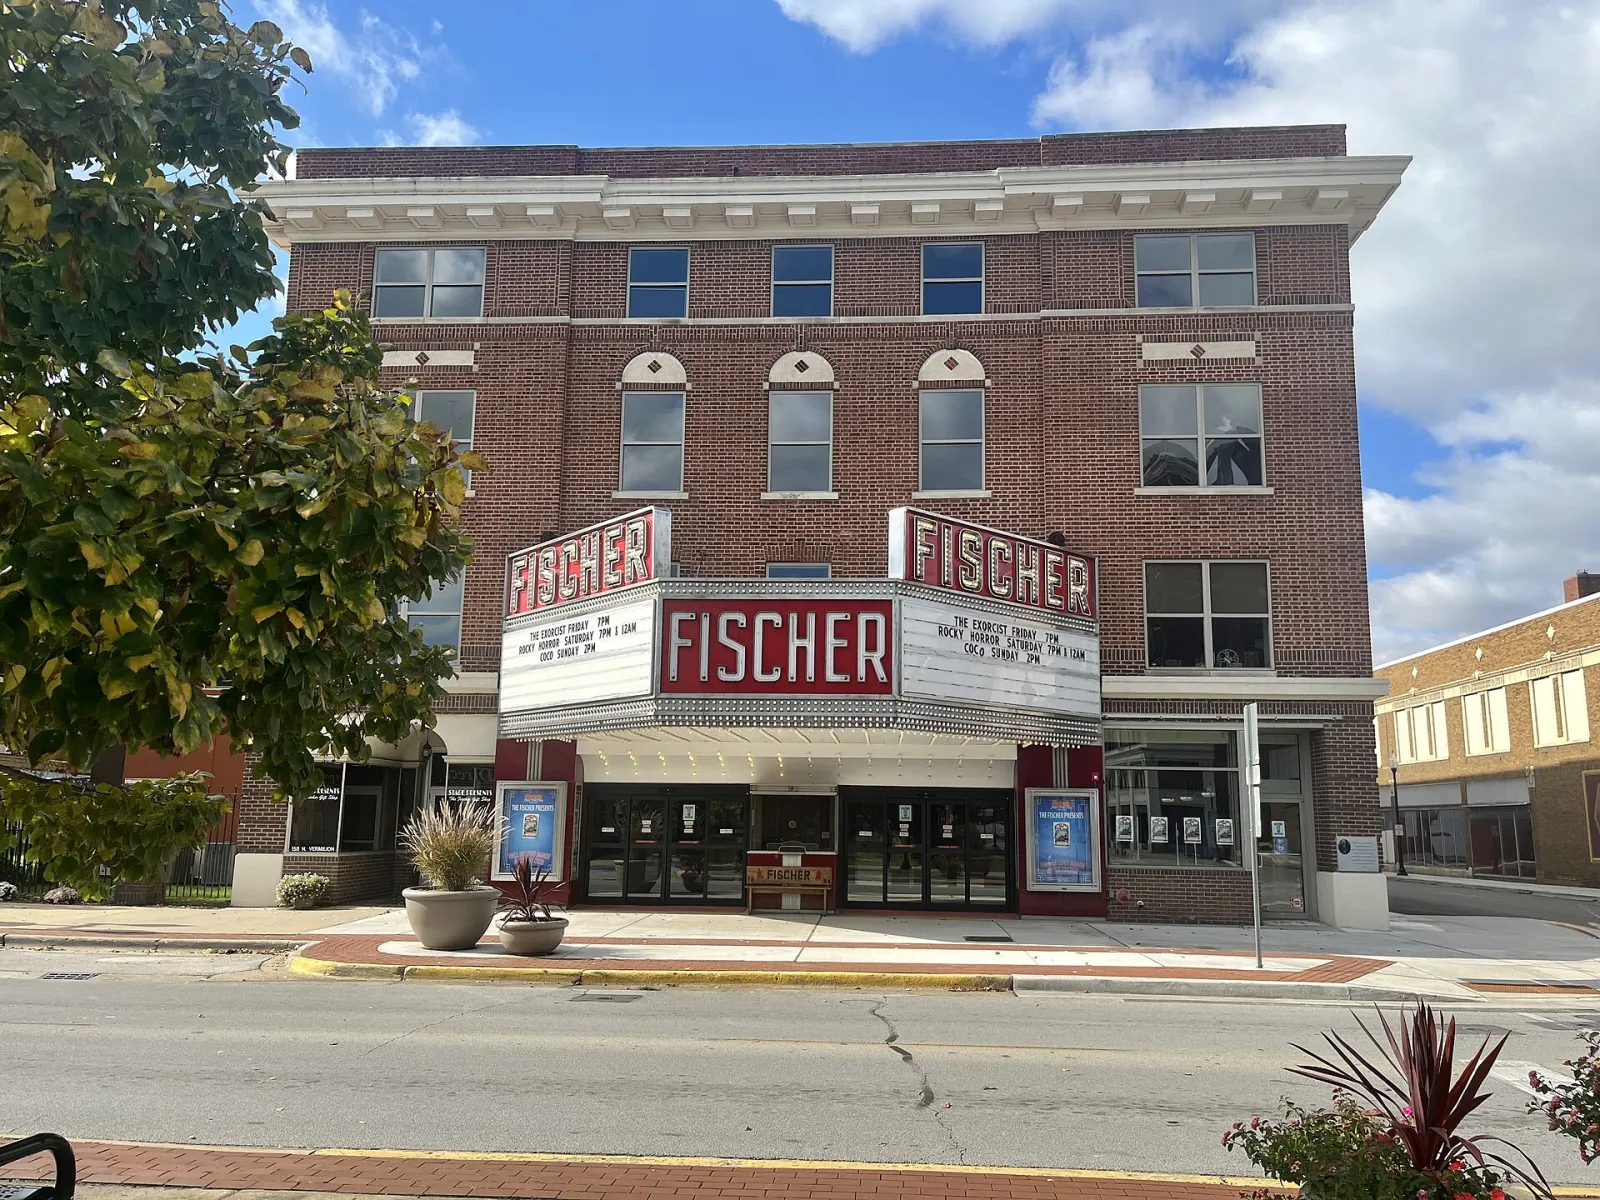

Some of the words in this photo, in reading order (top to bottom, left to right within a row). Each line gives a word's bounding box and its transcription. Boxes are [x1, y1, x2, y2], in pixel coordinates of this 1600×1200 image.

[509, 516, 648, 613] FISCHER
[913, 514, 1092, 616] FISCHER
[518, 644, 535, 655] ROCKY
[538, 640, 560, 650] HORROR
[564, 631, 594, 645] SATURDAY
[599, 627, 611, 639] 7PM
[621, 622, 637, 634] 12AM
[530, 631, 539, 641] THE
[541, 625, 566, 639] EXORCIST
[567, 620, 589, 633] FRIDAY
[597, 615, 610, 627] 7PM
[954, 616, 968, 628] THE
[973, 619, 1007, 635] EXORCIST
[1011, 627, 1037, 640] FRIDAY
[1045, 633, 1059, 644] 7PM
[540, 651, 553, 662] COCO
[557, 646, 579, 659] SUNDAY
[584, 643, 596, 654] 2PM
[669, 611, 888, 682] FISCHER
[938, 626, 964, 640] ROCKY
[970, 631, 1000, 645] HORROR
[1006, 638, 1043, 654] SATURDAY
[1047, 644, 1061, 656] 7PM
[1069, 648, 1085, 660] 12AM
[964, 642, 984, 657] COCO
[991, 647, 1018, 661] SUNDAY
[1026, 653, 1040, 664] 2PM
[535, 804, 554, 812] PRESENTS
[1038, 811, 1047, 819] THE
[1047, 811, 1064, 819] FISCHER
[1064, 811, 1084, 819] PRESENTS
[767, 869, 811, 880] FISCHER
